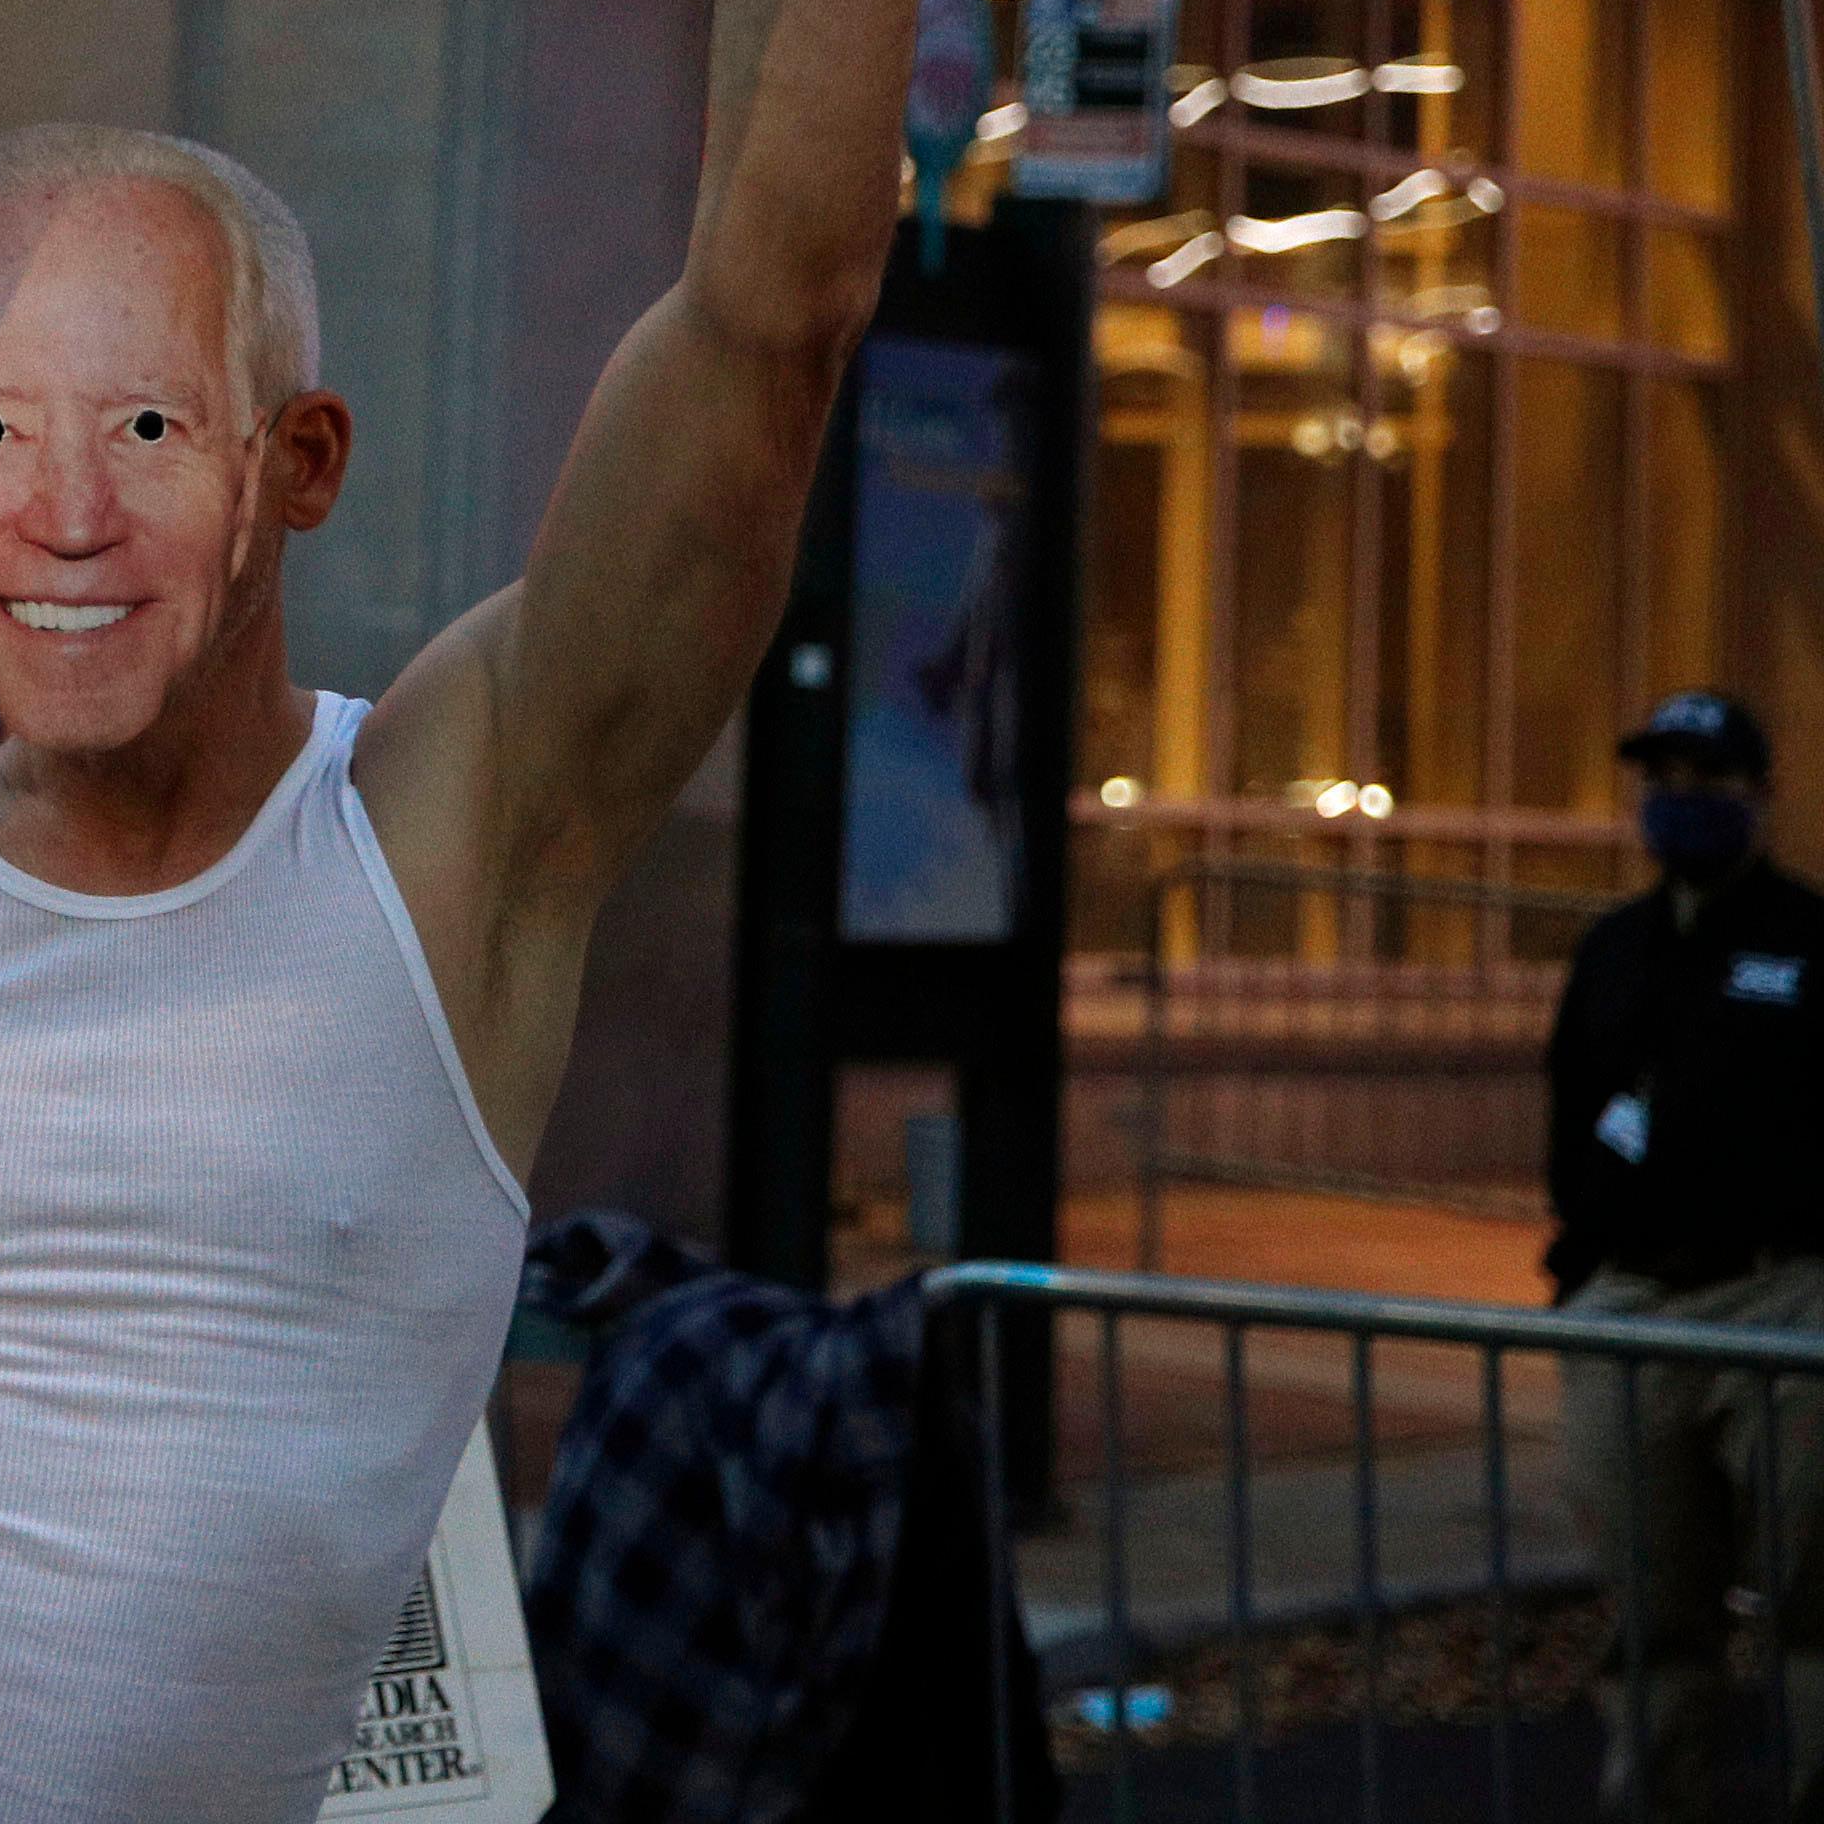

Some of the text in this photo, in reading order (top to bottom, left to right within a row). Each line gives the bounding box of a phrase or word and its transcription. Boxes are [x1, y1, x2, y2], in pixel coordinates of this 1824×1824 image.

[364, 1675, 451, 1719] DIA
[354, 1717, 458, 1750] EARCH
[326, 1747, 466, 1795] ENTER
